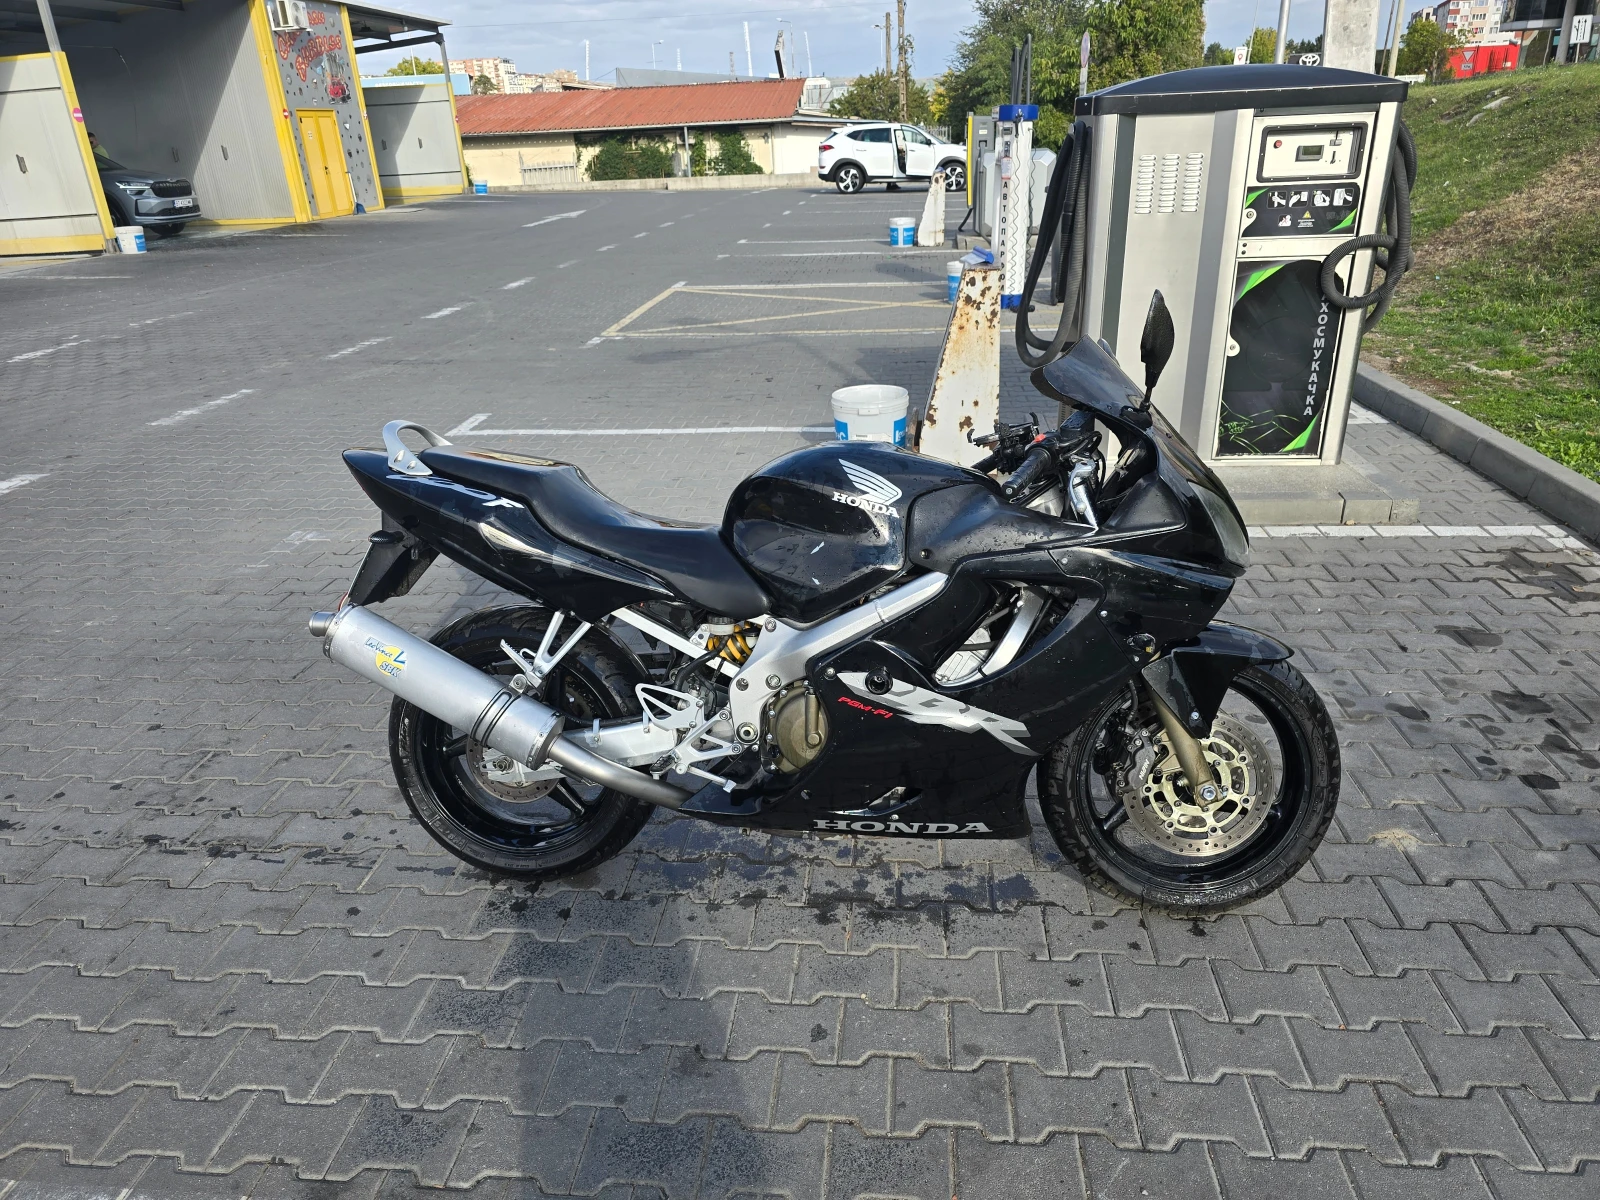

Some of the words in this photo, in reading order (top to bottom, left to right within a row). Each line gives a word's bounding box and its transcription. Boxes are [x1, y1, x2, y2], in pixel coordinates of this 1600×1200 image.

[307, 11, 325, 25] ASH
[1303, 295, 1330, 416] ХОСМУКАЧКА
[831, 491, 900, 519] HONDA
[837, 696, 894, 719] PGM-FI
[812, 819, 994, 835] HONDA
